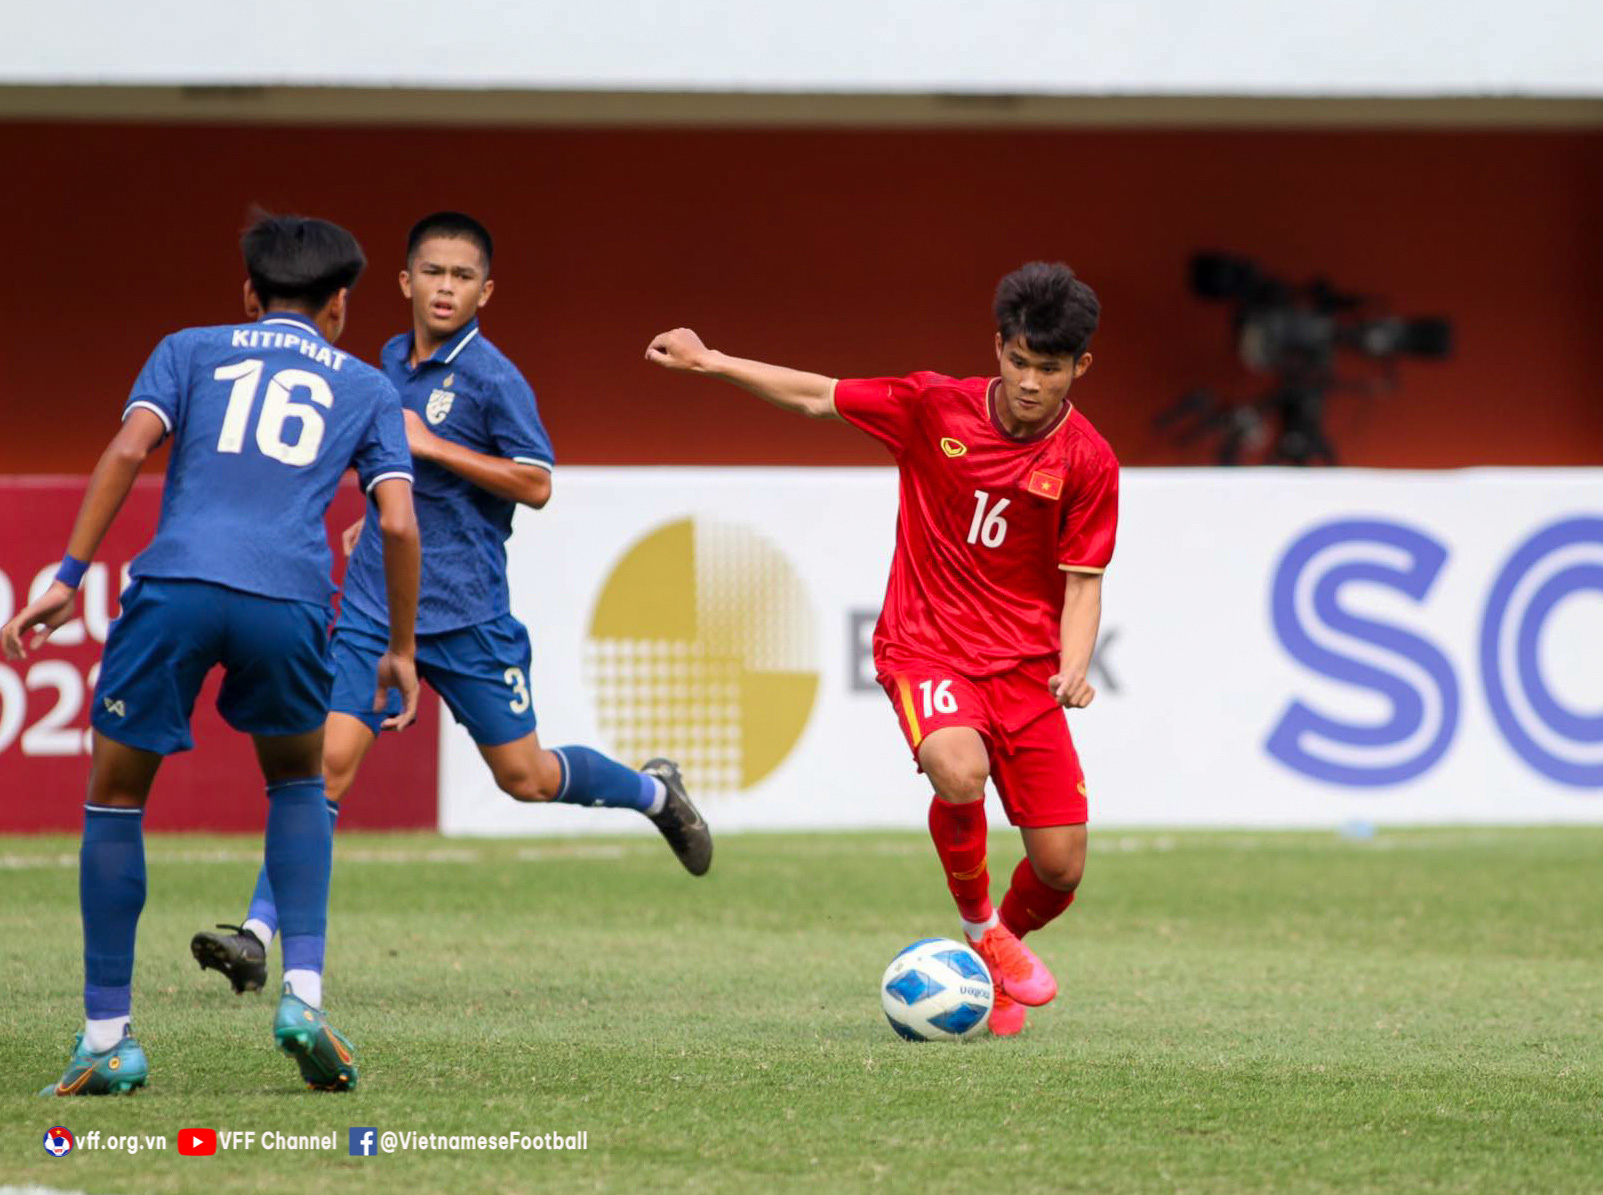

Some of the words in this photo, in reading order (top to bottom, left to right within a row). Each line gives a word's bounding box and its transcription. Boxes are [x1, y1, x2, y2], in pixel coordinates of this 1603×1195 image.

[232, 330, 347, 371] KITIPHAT
[213, 359, 334, 467] 16
[967, 490, 1011, 548] 16
[504, 667, 530, 714] 3
[919, 679, 959, 718] 16
